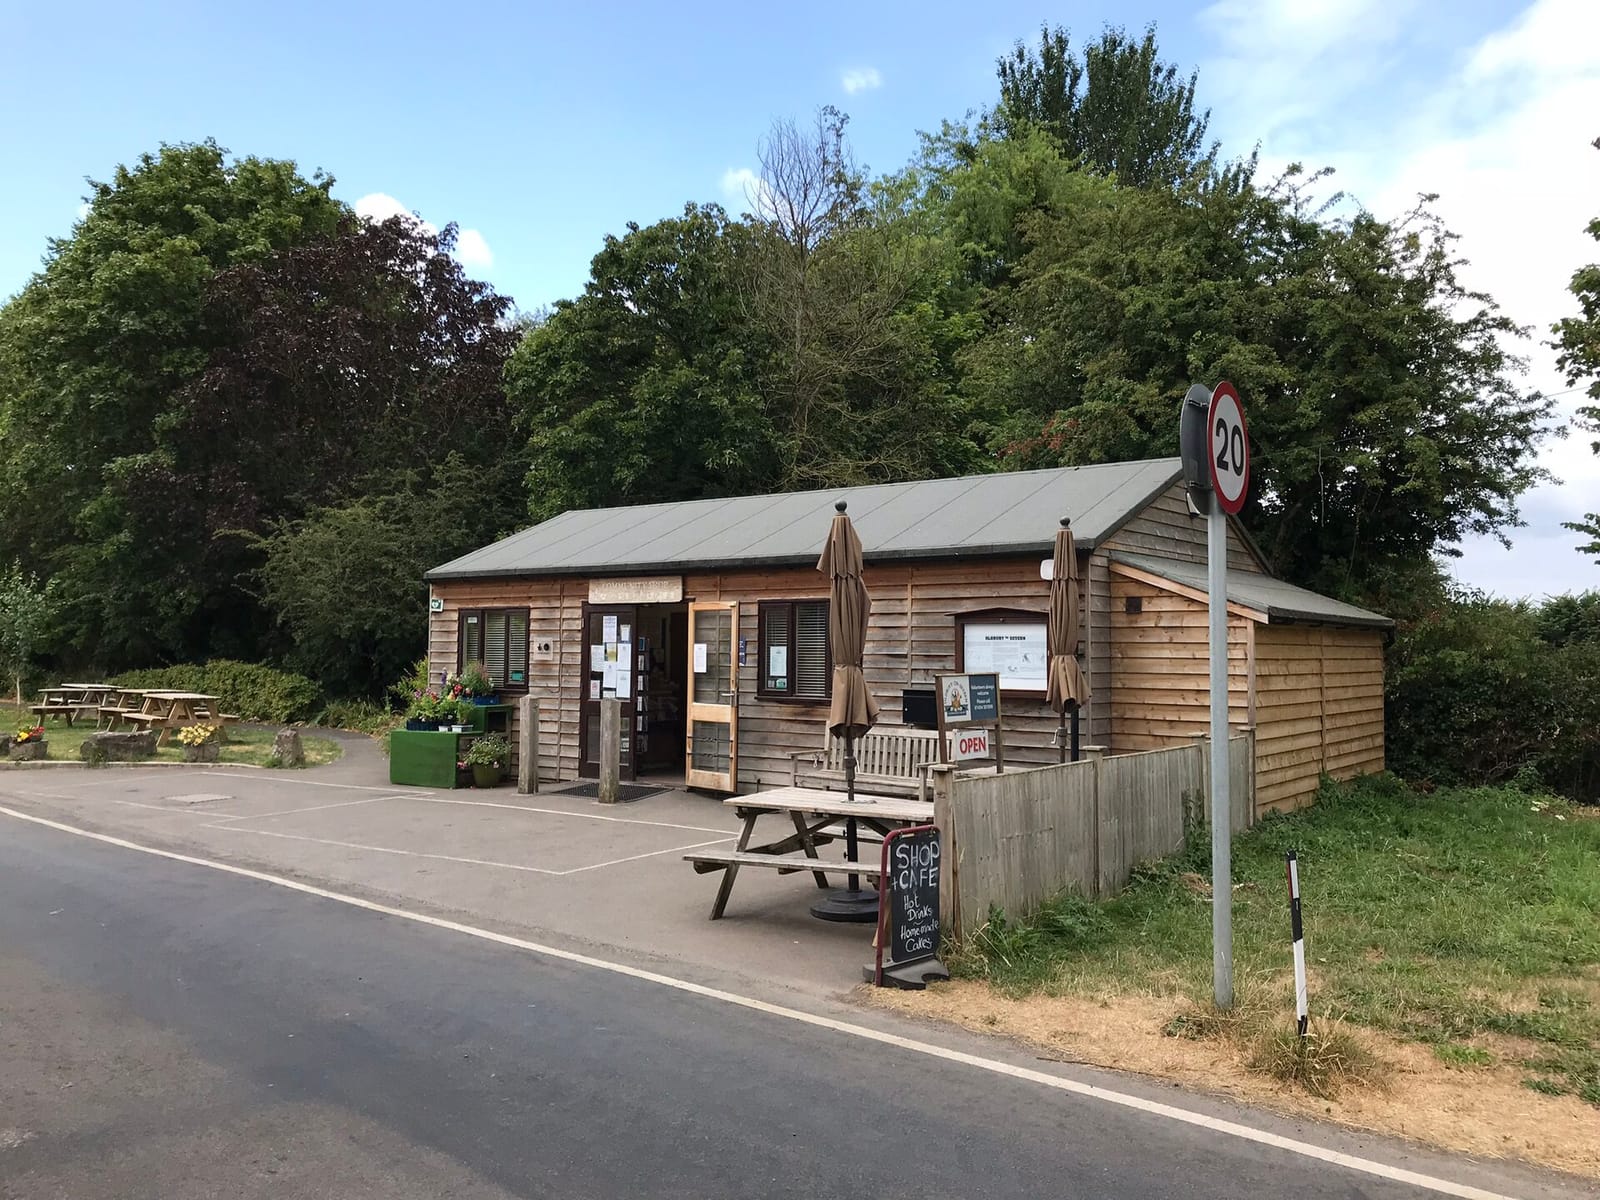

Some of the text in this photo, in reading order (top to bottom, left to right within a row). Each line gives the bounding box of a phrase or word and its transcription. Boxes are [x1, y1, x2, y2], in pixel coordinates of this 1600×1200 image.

[1216, 418, 1244, 476] 20
[960, 736, 986, 754] OPEN
[896, 841, 940, 868] SHOP
[903, 893, 920, 910] Hot
[907, 905, 933, 921] Drinks
[905, 938, 933, 953] Cakes
